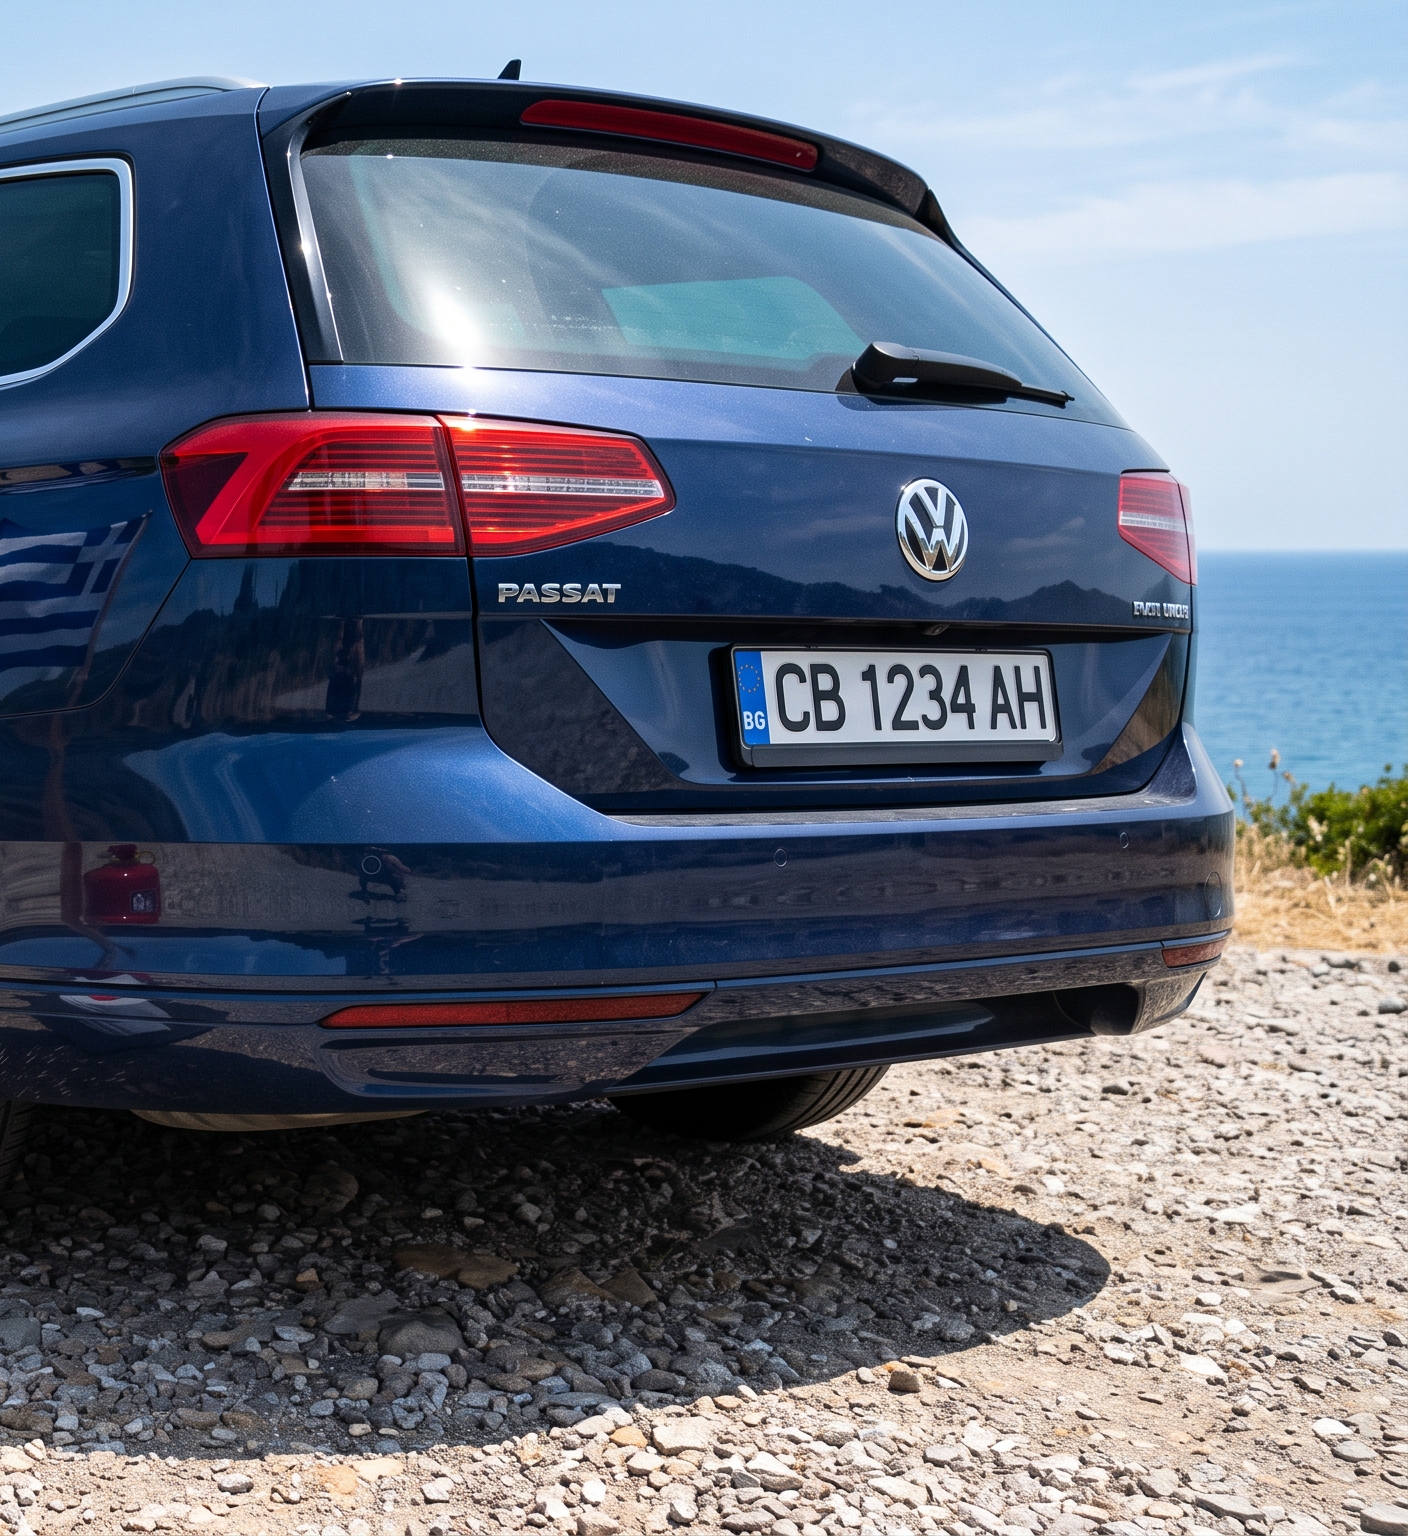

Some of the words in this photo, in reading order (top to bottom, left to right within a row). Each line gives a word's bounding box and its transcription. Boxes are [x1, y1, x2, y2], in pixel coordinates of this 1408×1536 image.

[898, 478, 969, 581] VW
[497, 583, 622, 603] PASSAT
[775, 663, 846, 732] CB
[861, 664, 976, 731] 1234
[990, 665, 1047, 730] AH
[743, 711, 766, 730] BG
